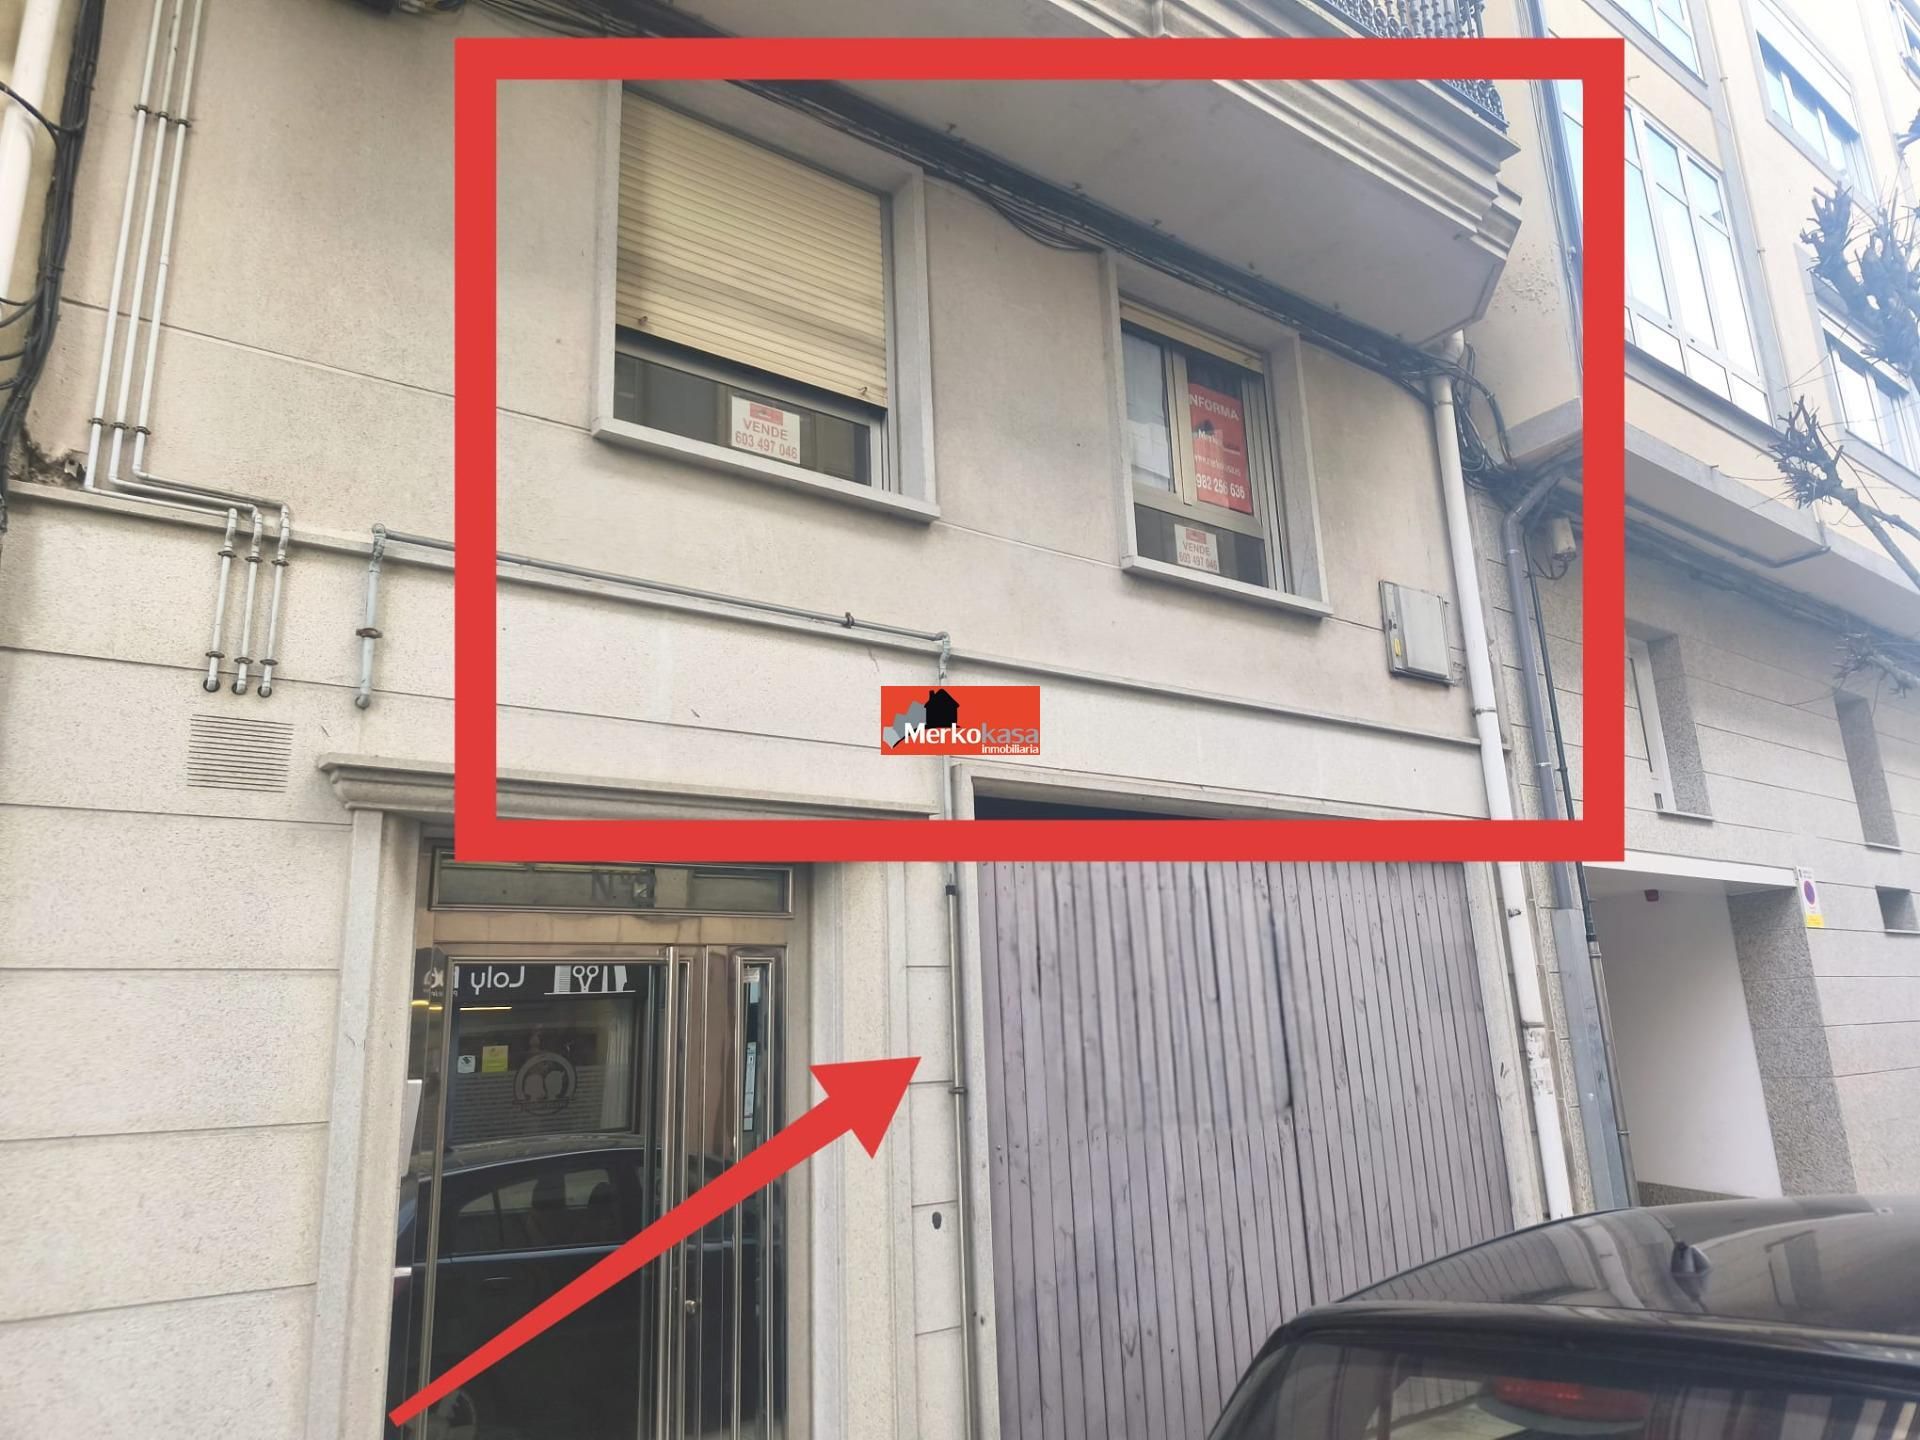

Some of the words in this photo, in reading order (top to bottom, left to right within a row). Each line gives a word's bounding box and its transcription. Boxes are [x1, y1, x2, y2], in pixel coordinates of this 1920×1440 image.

[1189, 393, 1240, 421] NFORMA
[743, 417, 789, 441] VENDE
[735, 430, 754, 447] 603
[757, 438, 776, 453] 497
[779, 443, 798, 459] 046
[1196, 473, 1212, 491] 982
